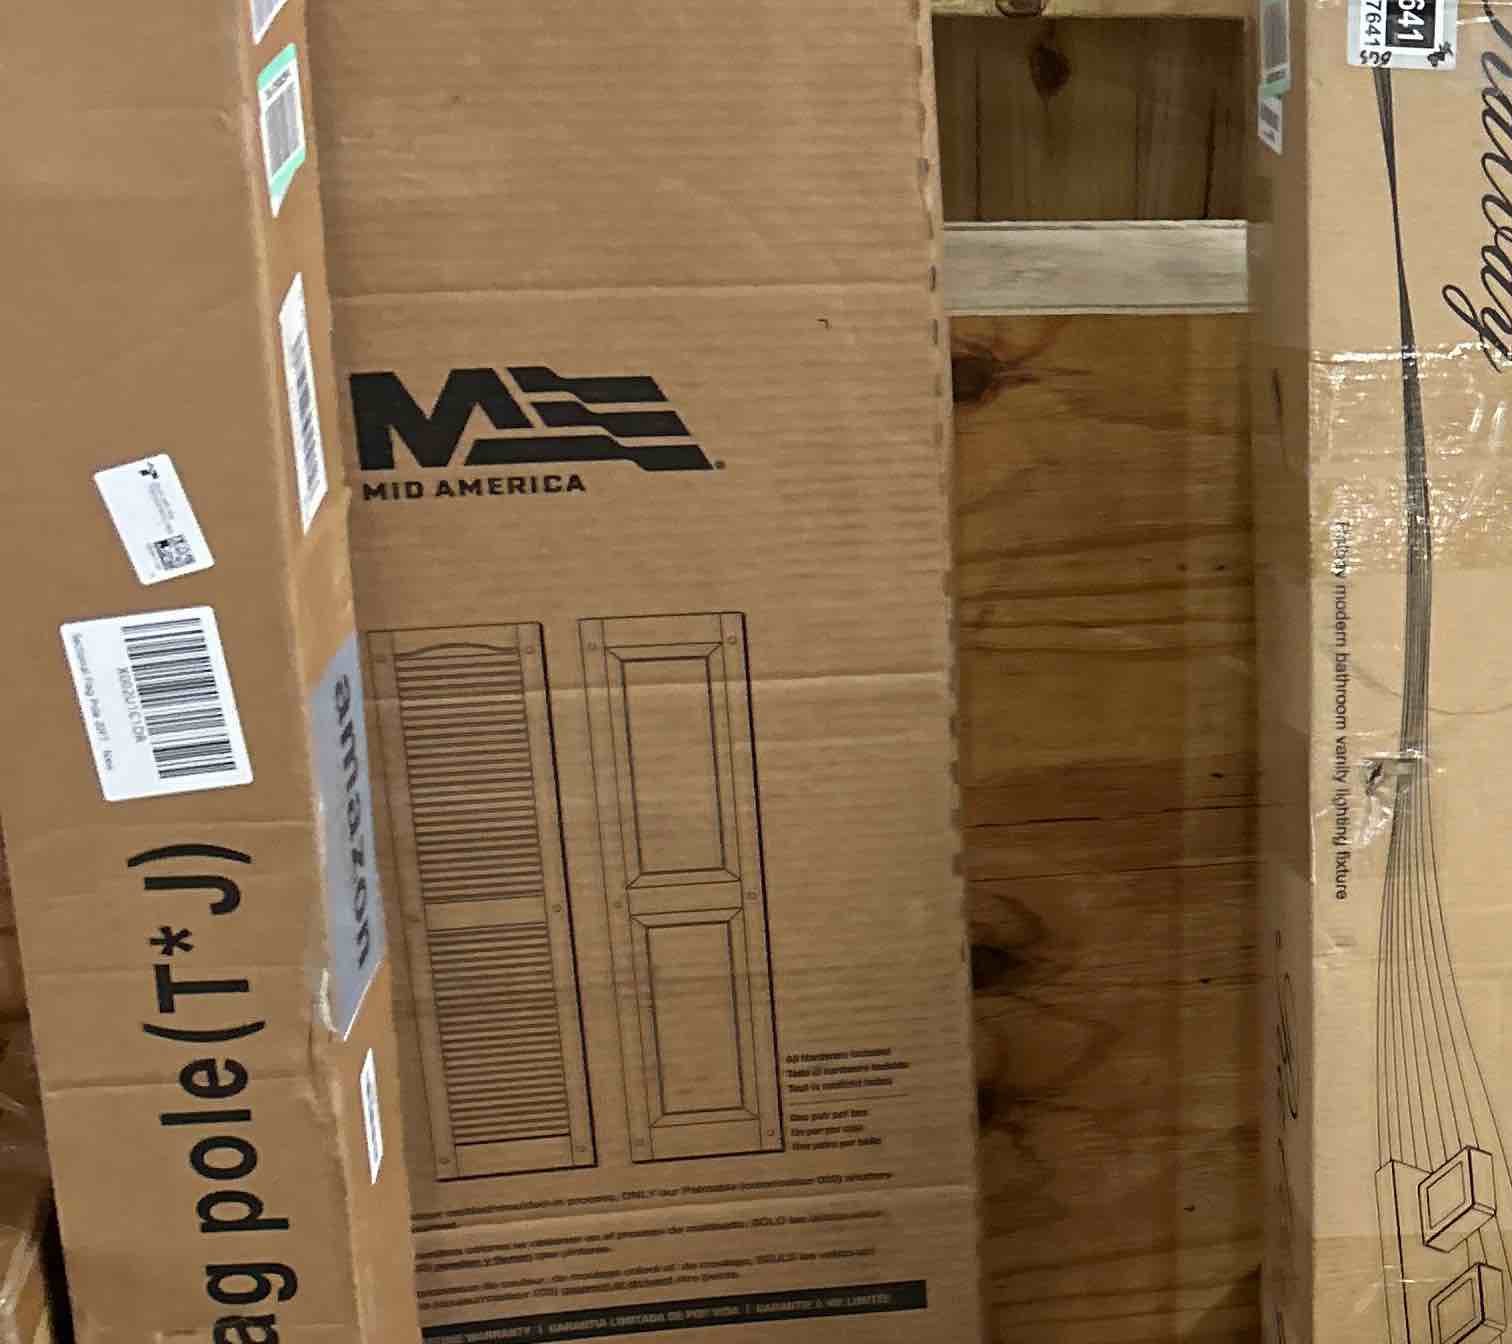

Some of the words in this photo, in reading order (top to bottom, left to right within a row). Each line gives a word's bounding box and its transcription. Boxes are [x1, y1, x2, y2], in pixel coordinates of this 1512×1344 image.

[434, 473, 586, 497] AMERICA
[1335, 584, 1347, 648] modern
[1335, 653, 1350, 732] bathroom
[1331, 736, 1347, 784] vanity
[334, 674, 371, 971] amazon
[1331, 788, 1349, 847] lighting
[1335, 851, 1350, 901] fixture
